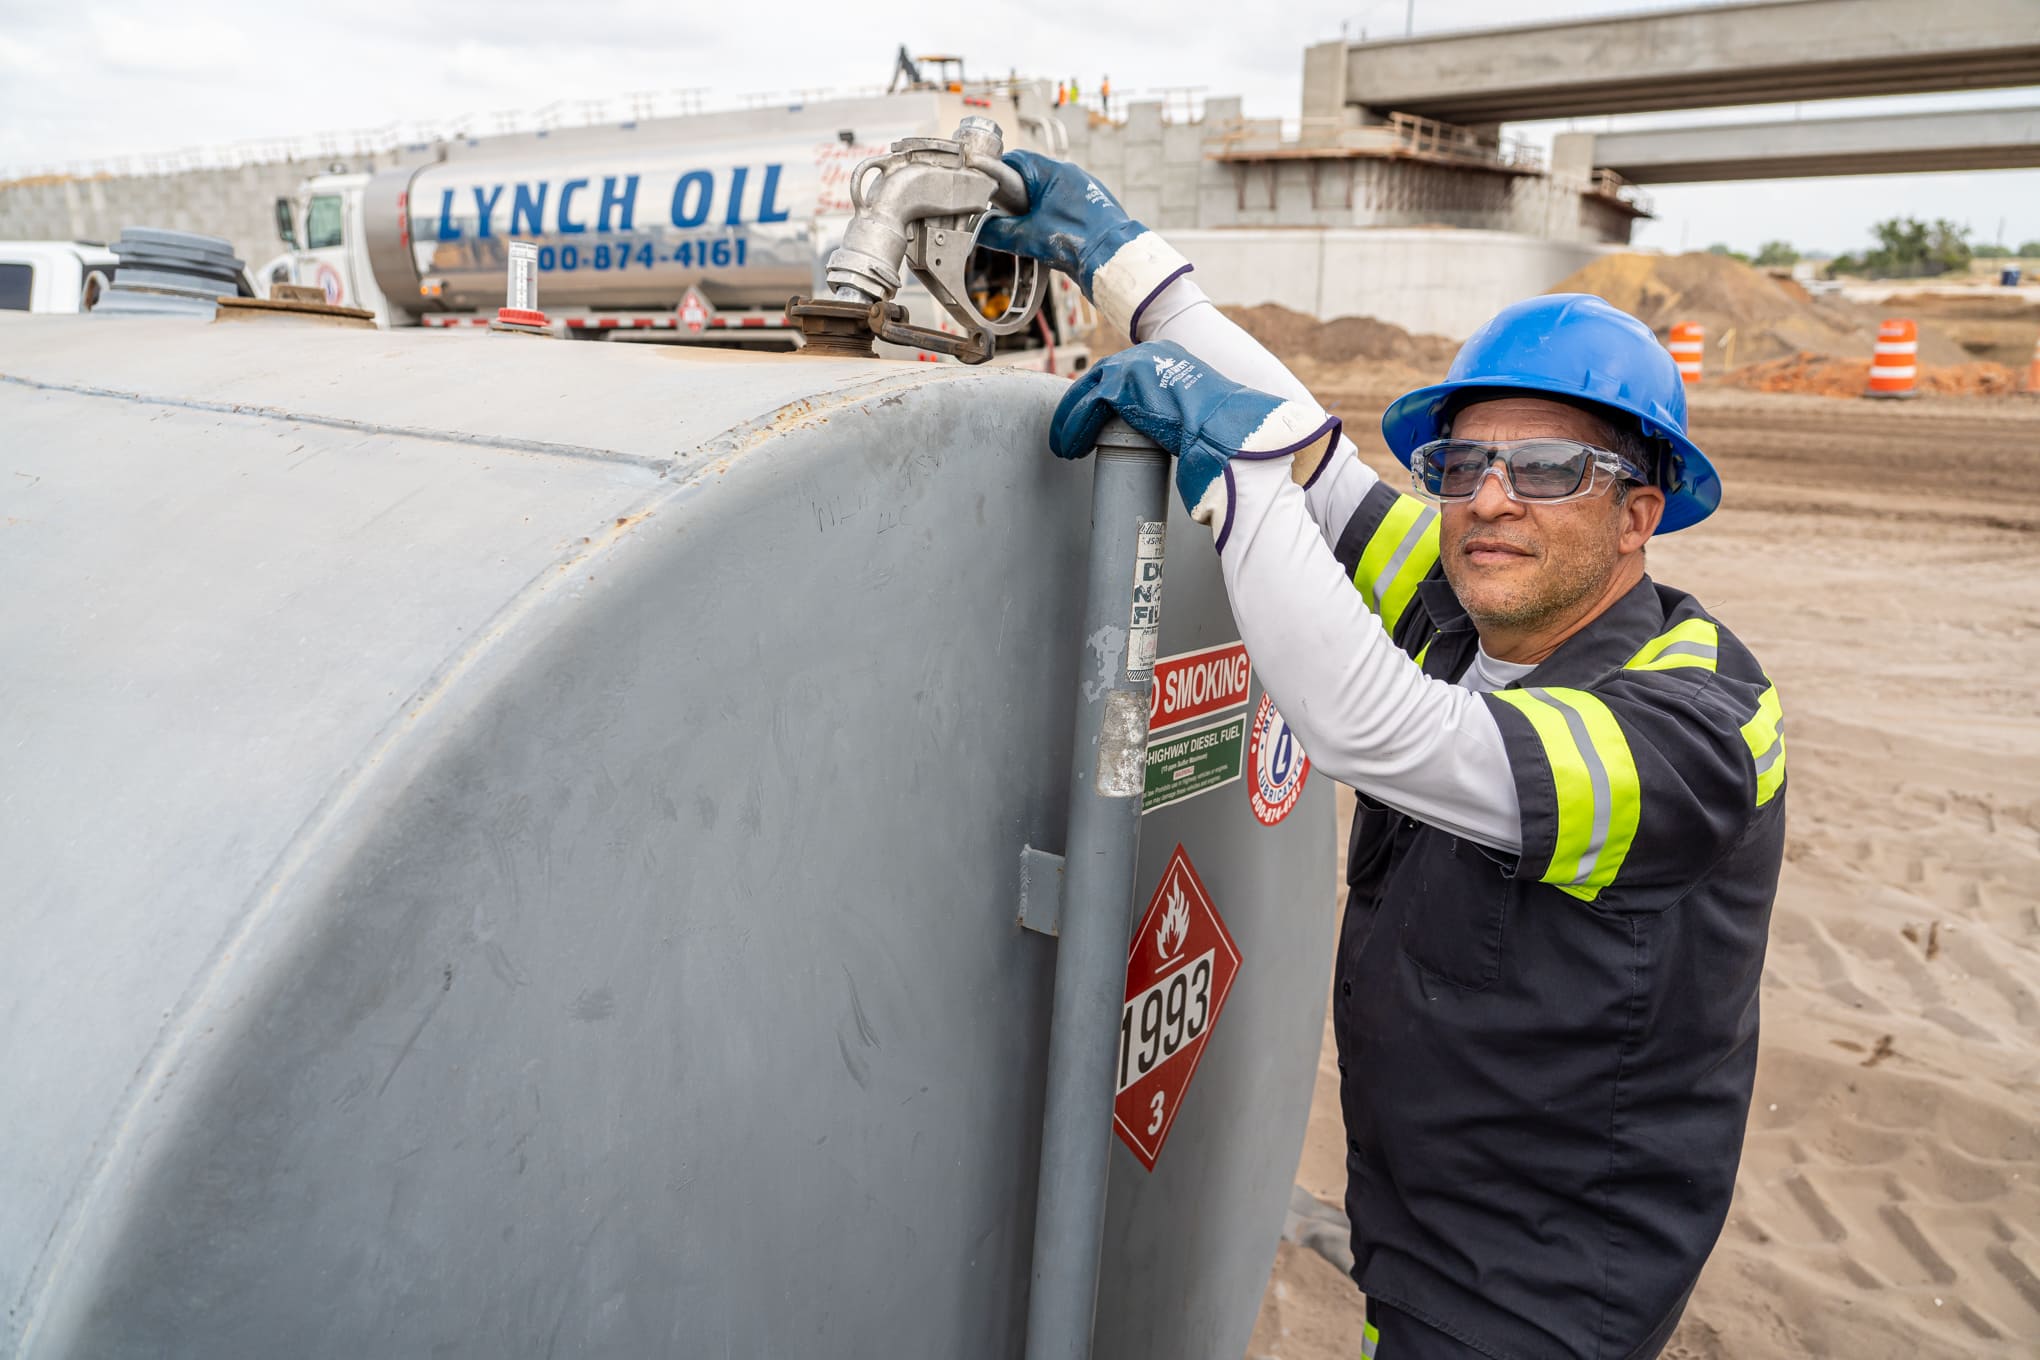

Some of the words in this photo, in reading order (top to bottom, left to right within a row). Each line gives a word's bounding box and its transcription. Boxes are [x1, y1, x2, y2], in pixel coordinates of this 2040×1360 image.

[437, 175, 640, 241] LYNCH
[670, 163, 789, 229] OIL
[538, 237, 748, 272] 00-874-4161
[1163, 652, 1247, 714] SMOKING
[1190, 732, 1219, 753] DIESEL
[1220, 725, 1241, 743] FUEL
[1252, 691, 1270, 740] LYNC
[1119, 959, 1210, 1089] 1993
[1147, 1090, 1165, 1136] 3
